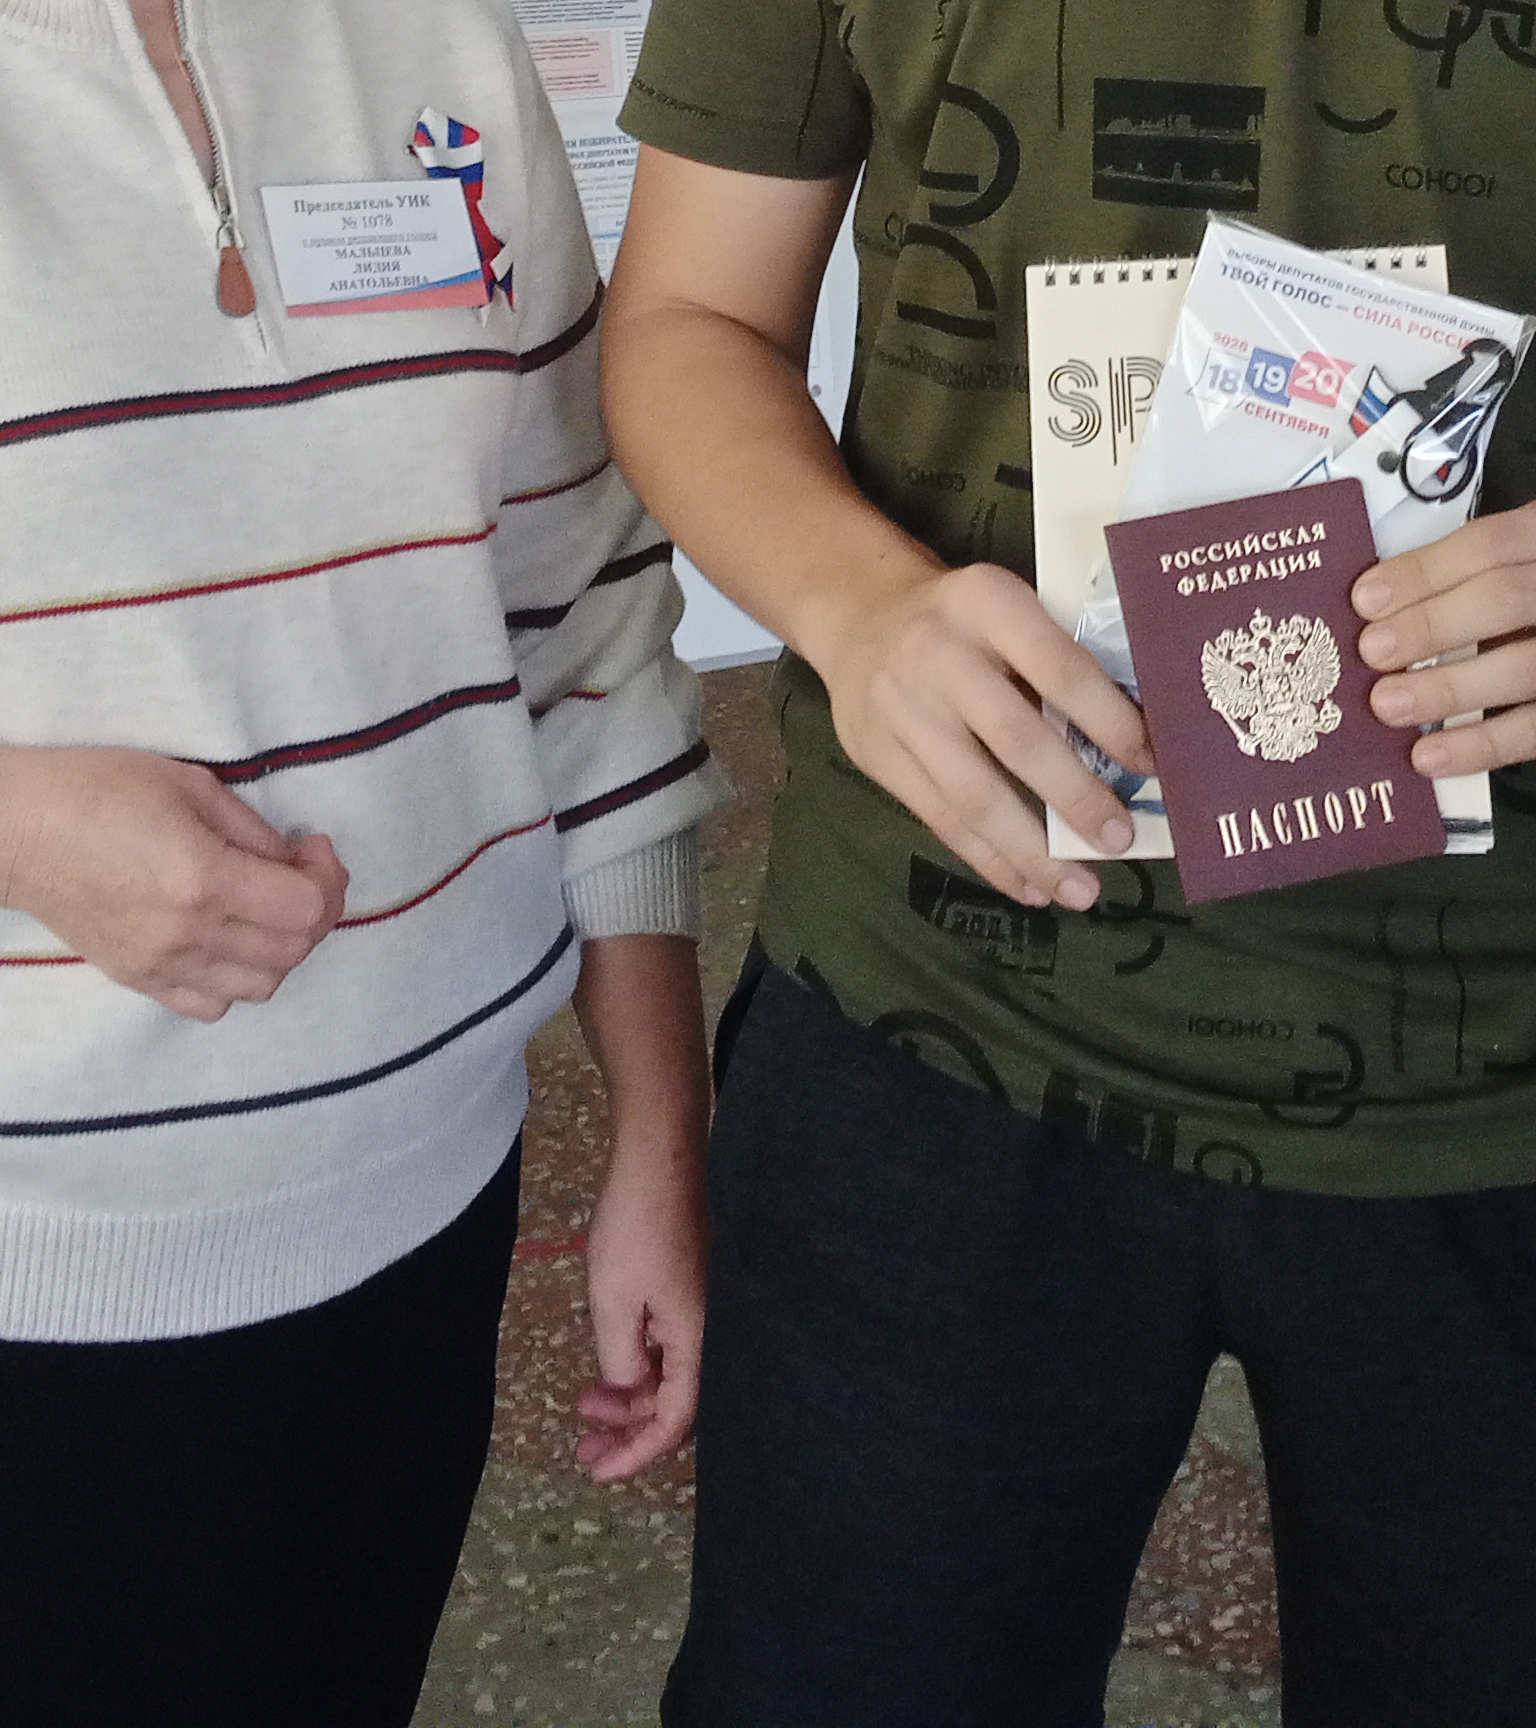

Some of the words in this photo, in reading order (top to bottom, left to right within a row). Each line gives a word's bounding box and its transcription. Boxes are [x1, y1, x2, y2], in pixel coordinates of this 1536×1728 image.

[293, 198, 394, 216] Председатель
[395, 193, 432, 209] УИК
[341, 215, 359, 231] №
[362, 213, 394, 229] 1078
[329, 274, 431, 292] АНАТОЛЬЕВНА
[352, 260, 402, 275] ЛИДИЯ
[1221, 263, 1270, 290] ТВОЙ
[1272, 279, 1334, 309] ГОЛОС
[1352, 305, 1403, 332] СИЛА
[1407, 320, 1475, 351] РОССИ
[1227, 248, 1277, 271] ВЫБОРЫ
[1277, 263, 1345, 291] ДЕПУТАТОВ
[1345, 283, 1458, 329] ГОСУДАРСТВЕННОЙ
[1458, 319, 1496, 338] ДУМЫ
[1208, 362, 1241, 396] 18
[1252, 362, 1288, 395] 19
[1293, 360, 1340, 396] 20
[1244, 401, 1330, 440] СЕНТЯБРЯ
[1160, 521, 1327, 574] РОССИЙСКАЯ
[1175, 548, 1324, 598] ФЕДЕРАЦИЯ
[1216, 779, 1397, 860] ПАСПОРТ
